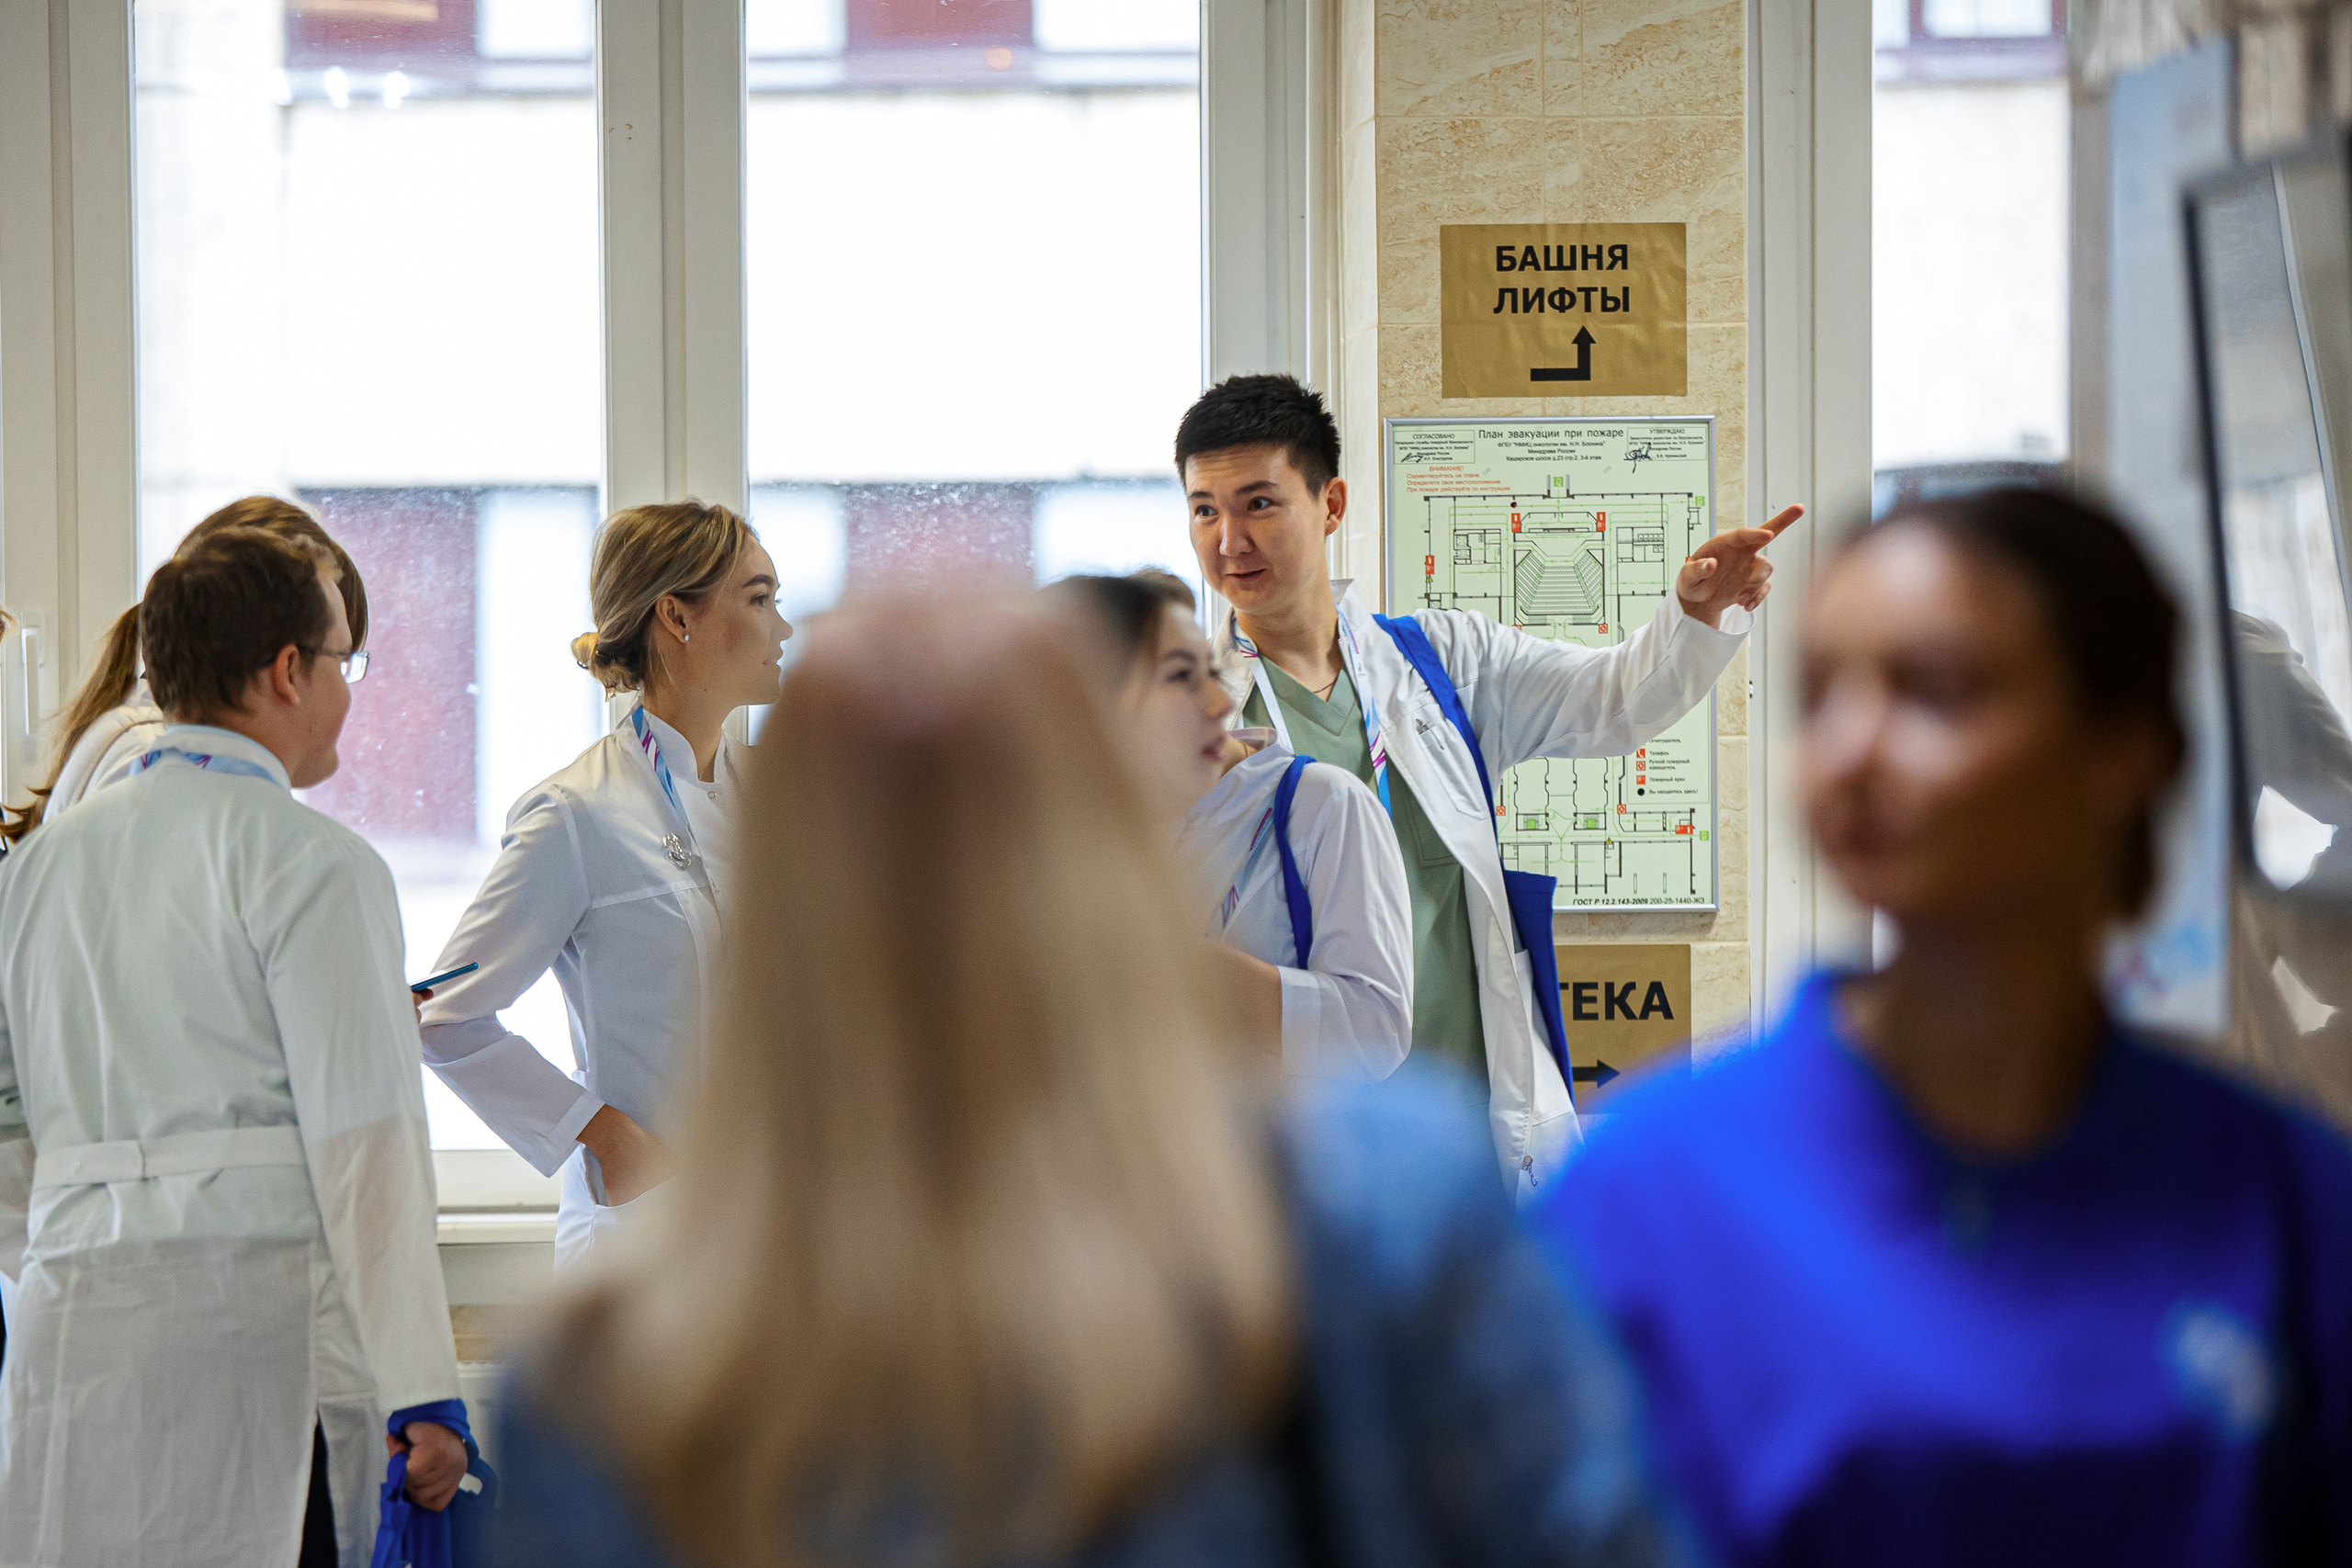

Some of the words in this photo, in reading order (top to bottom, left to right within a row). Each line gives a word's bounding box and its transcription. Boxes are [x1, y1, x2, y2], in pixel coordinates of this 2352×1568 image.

[1496, 244, 1628, 271] БАШНЯ
[1493, 287, 1630, 314] ЛИФТЫ
[1478, 430, 1503, 439] План
[1508, 430, 1560, 440] эвакуации
[1565, 430, 1582, 439] при
[1587, 429, 1623, 439] пожаре
[1601, 897, 1648, 906] 12.2.143-2009
[1559, 981, 1674, 1021] ЕКА
